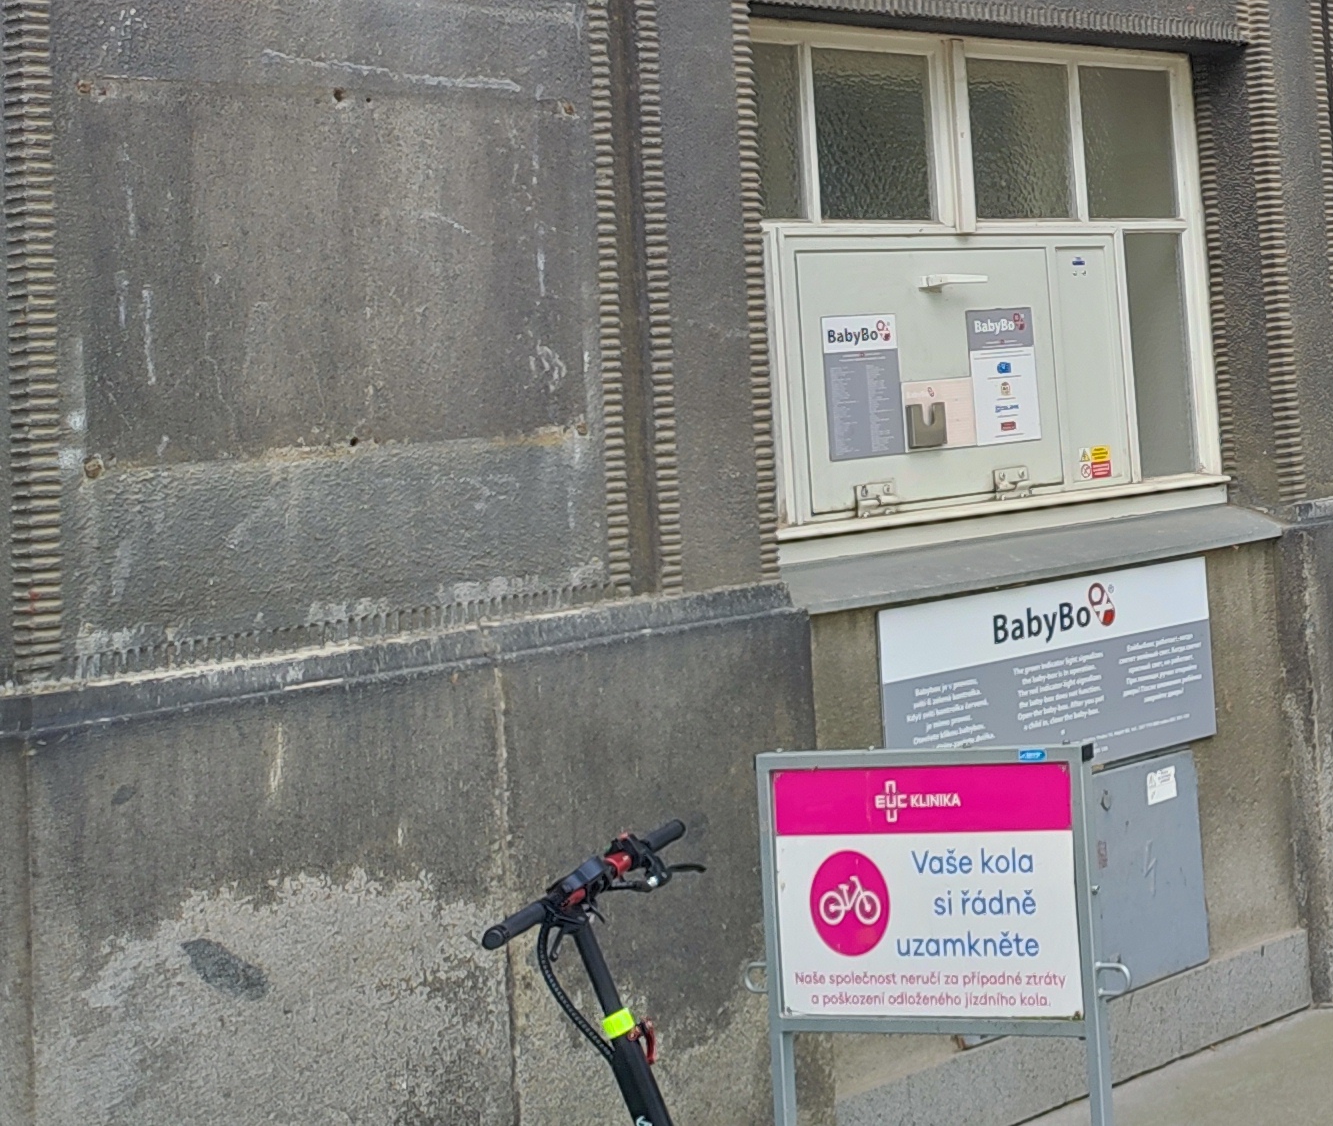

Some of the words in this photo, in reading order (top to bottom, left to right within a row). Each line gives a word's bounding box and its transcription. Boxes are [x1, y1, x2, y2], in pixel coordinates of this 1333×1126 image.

[910, 793, 961, 808] KLINIKA
[911, 848, 972, 874] Vaše
[981, 847, 1033, 873] kola
[934, 890, 952, 916] si
[961, 889, 1036, 916] řádně
[896, 930, 1039, 957] uzamkněte
[795, 971, 826, 985] Naše
[829, 971, 897, 987] společnost
[901, 971, 941, 985] neručí
[944, 974, 958, 985] za
[963, 971, 1022, 988] případné
[1025, 971, 1066, 989] ztráty
[811, 994, 819, 1005] a
[823, 991, 885, 1007] poškození
[888, 991, 961, 1005] odloženého
[965, 992, 1017, 1009] jízdního
